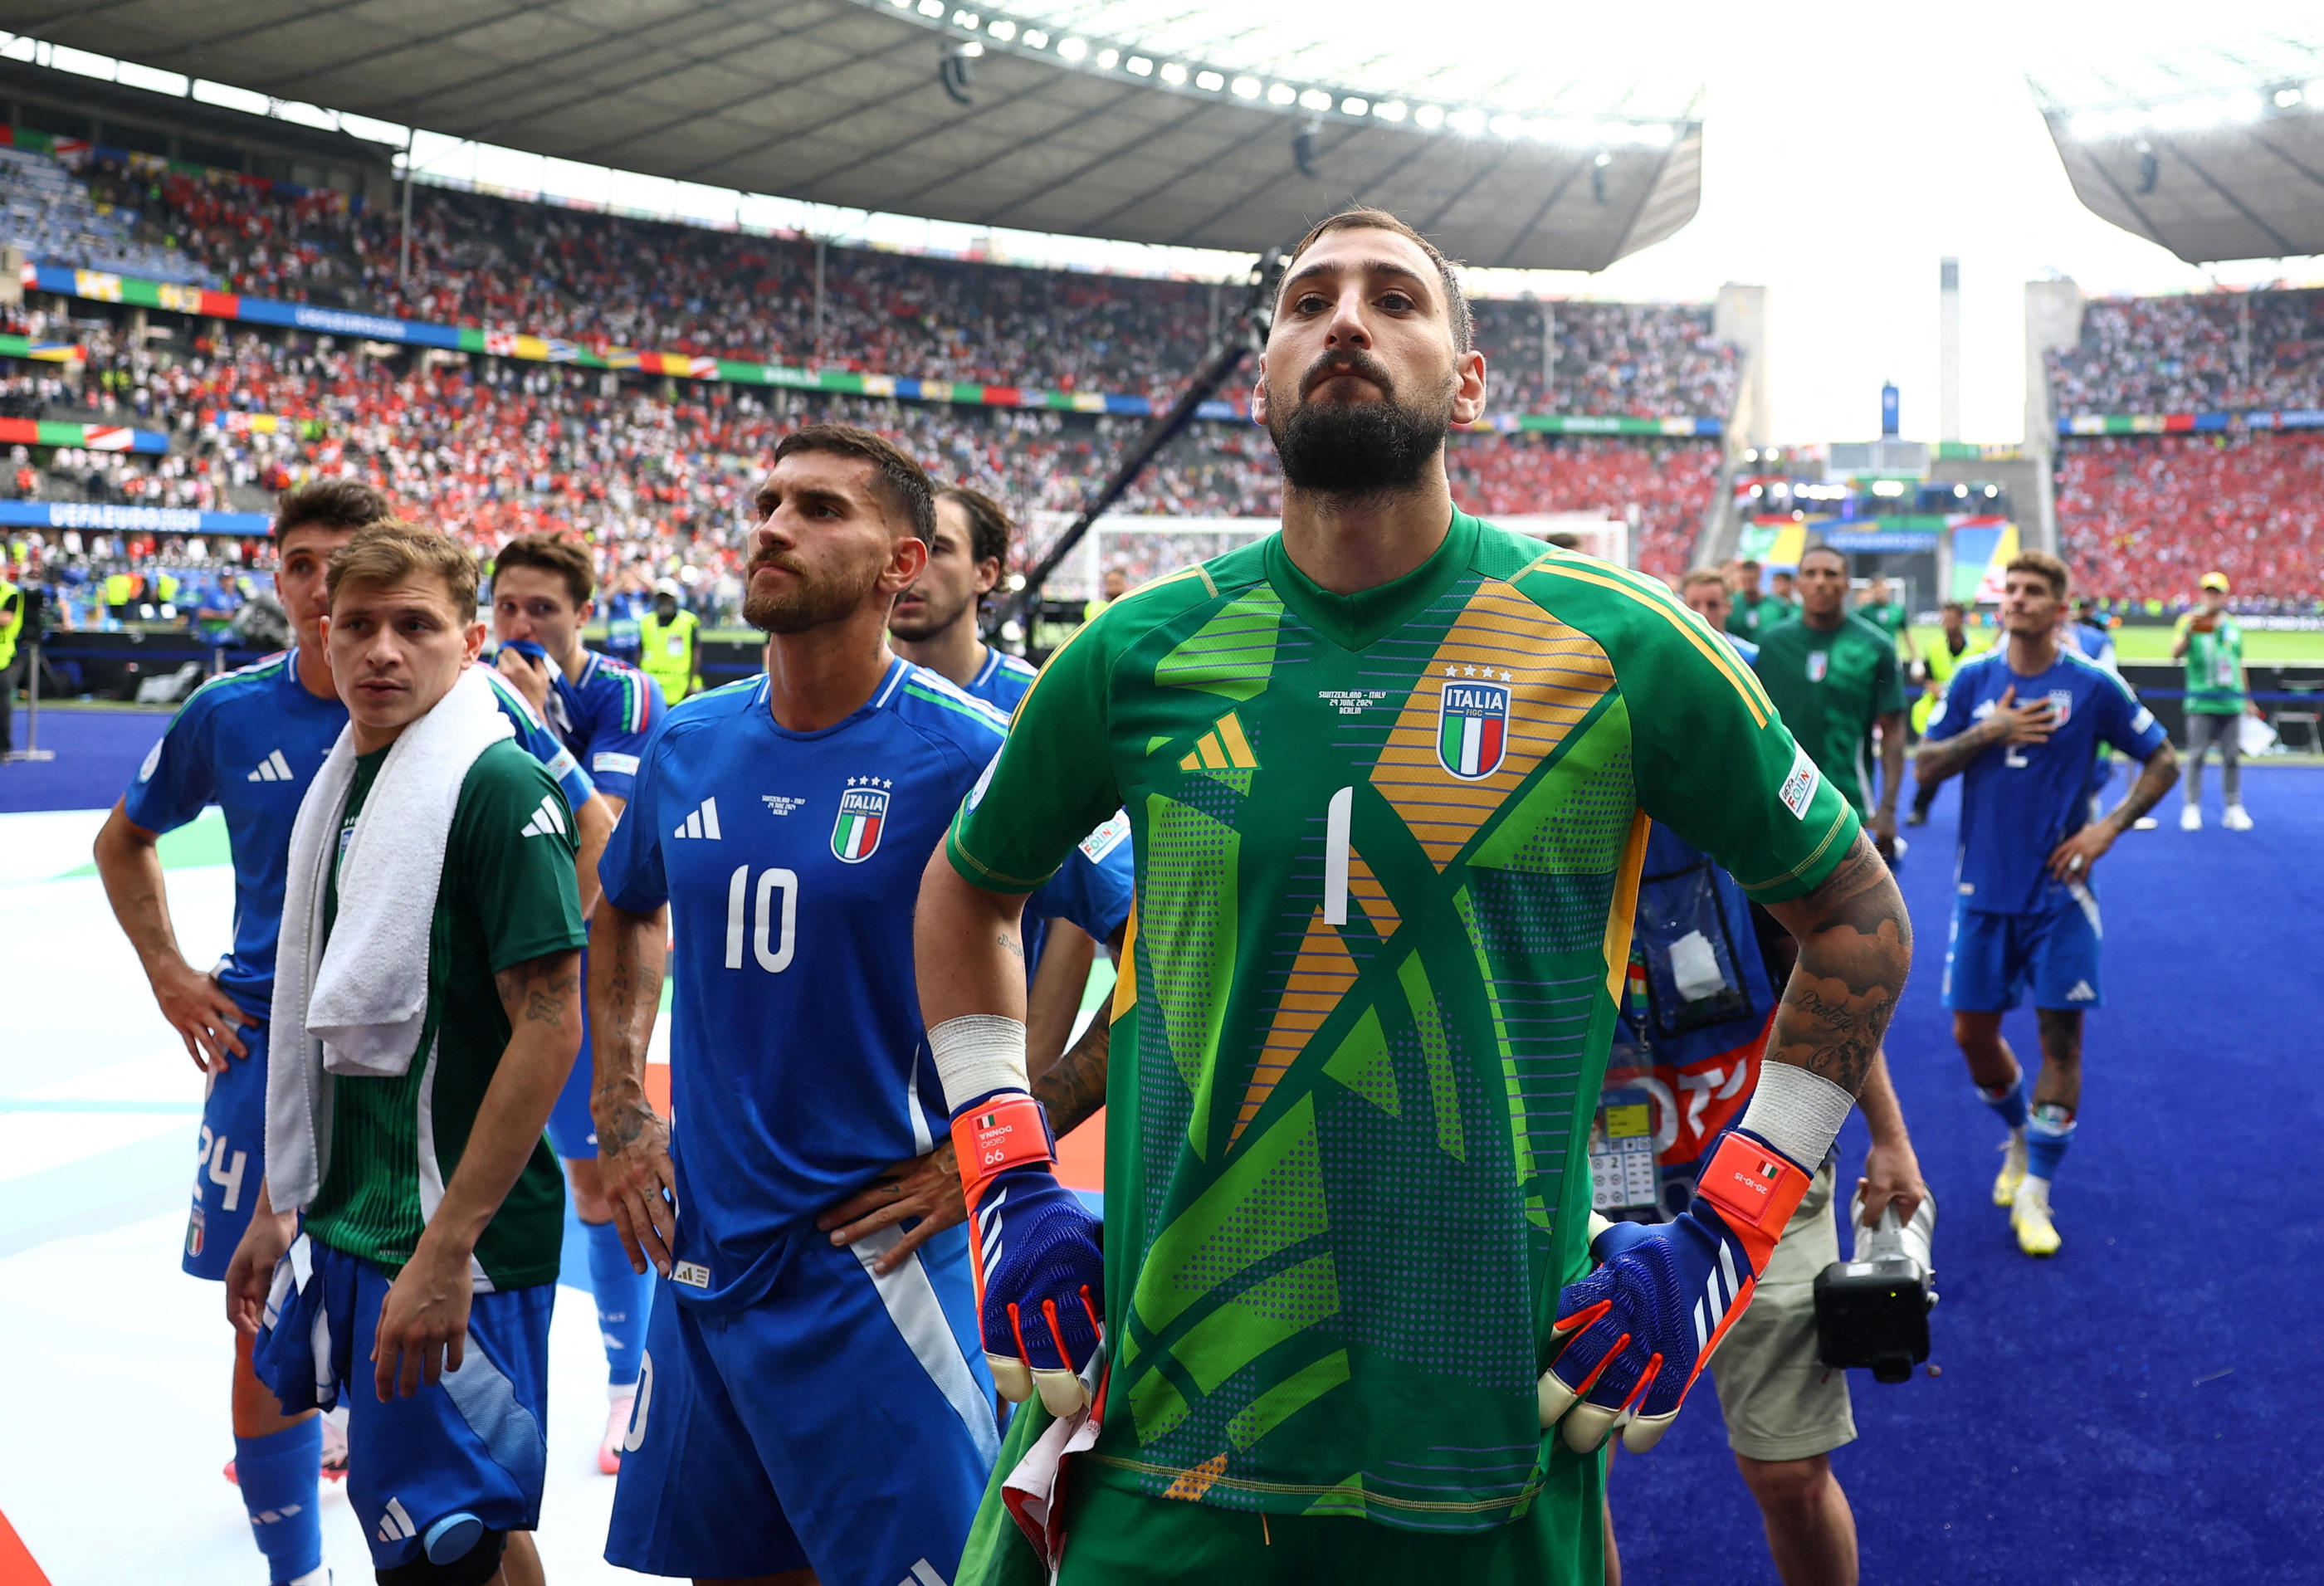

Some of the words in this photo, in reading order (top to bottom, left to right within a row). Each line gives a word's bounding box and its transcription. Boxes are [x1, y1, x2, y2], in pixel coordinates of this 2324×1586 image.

[1318, 691, 1362, 699] SWITZERLAND
[1446, 688, 1503, 710] ITALIA
[1339, 706, 1361, 715] BERLIN
[1787, 765, 1811, 810] FOUN
[843, 794, 883, 811] ITALIA
[1324, 786, 1353, 925] 1
[725, 864, 798, 974] 10
[979, 1125, 1013, 1139] DONNA
[981, 1136, 1005, 1149] GIGIO
[1611, 1157, 1618, 1169] 2
[1734, 1172, 1768, 1195] 20-10-15
